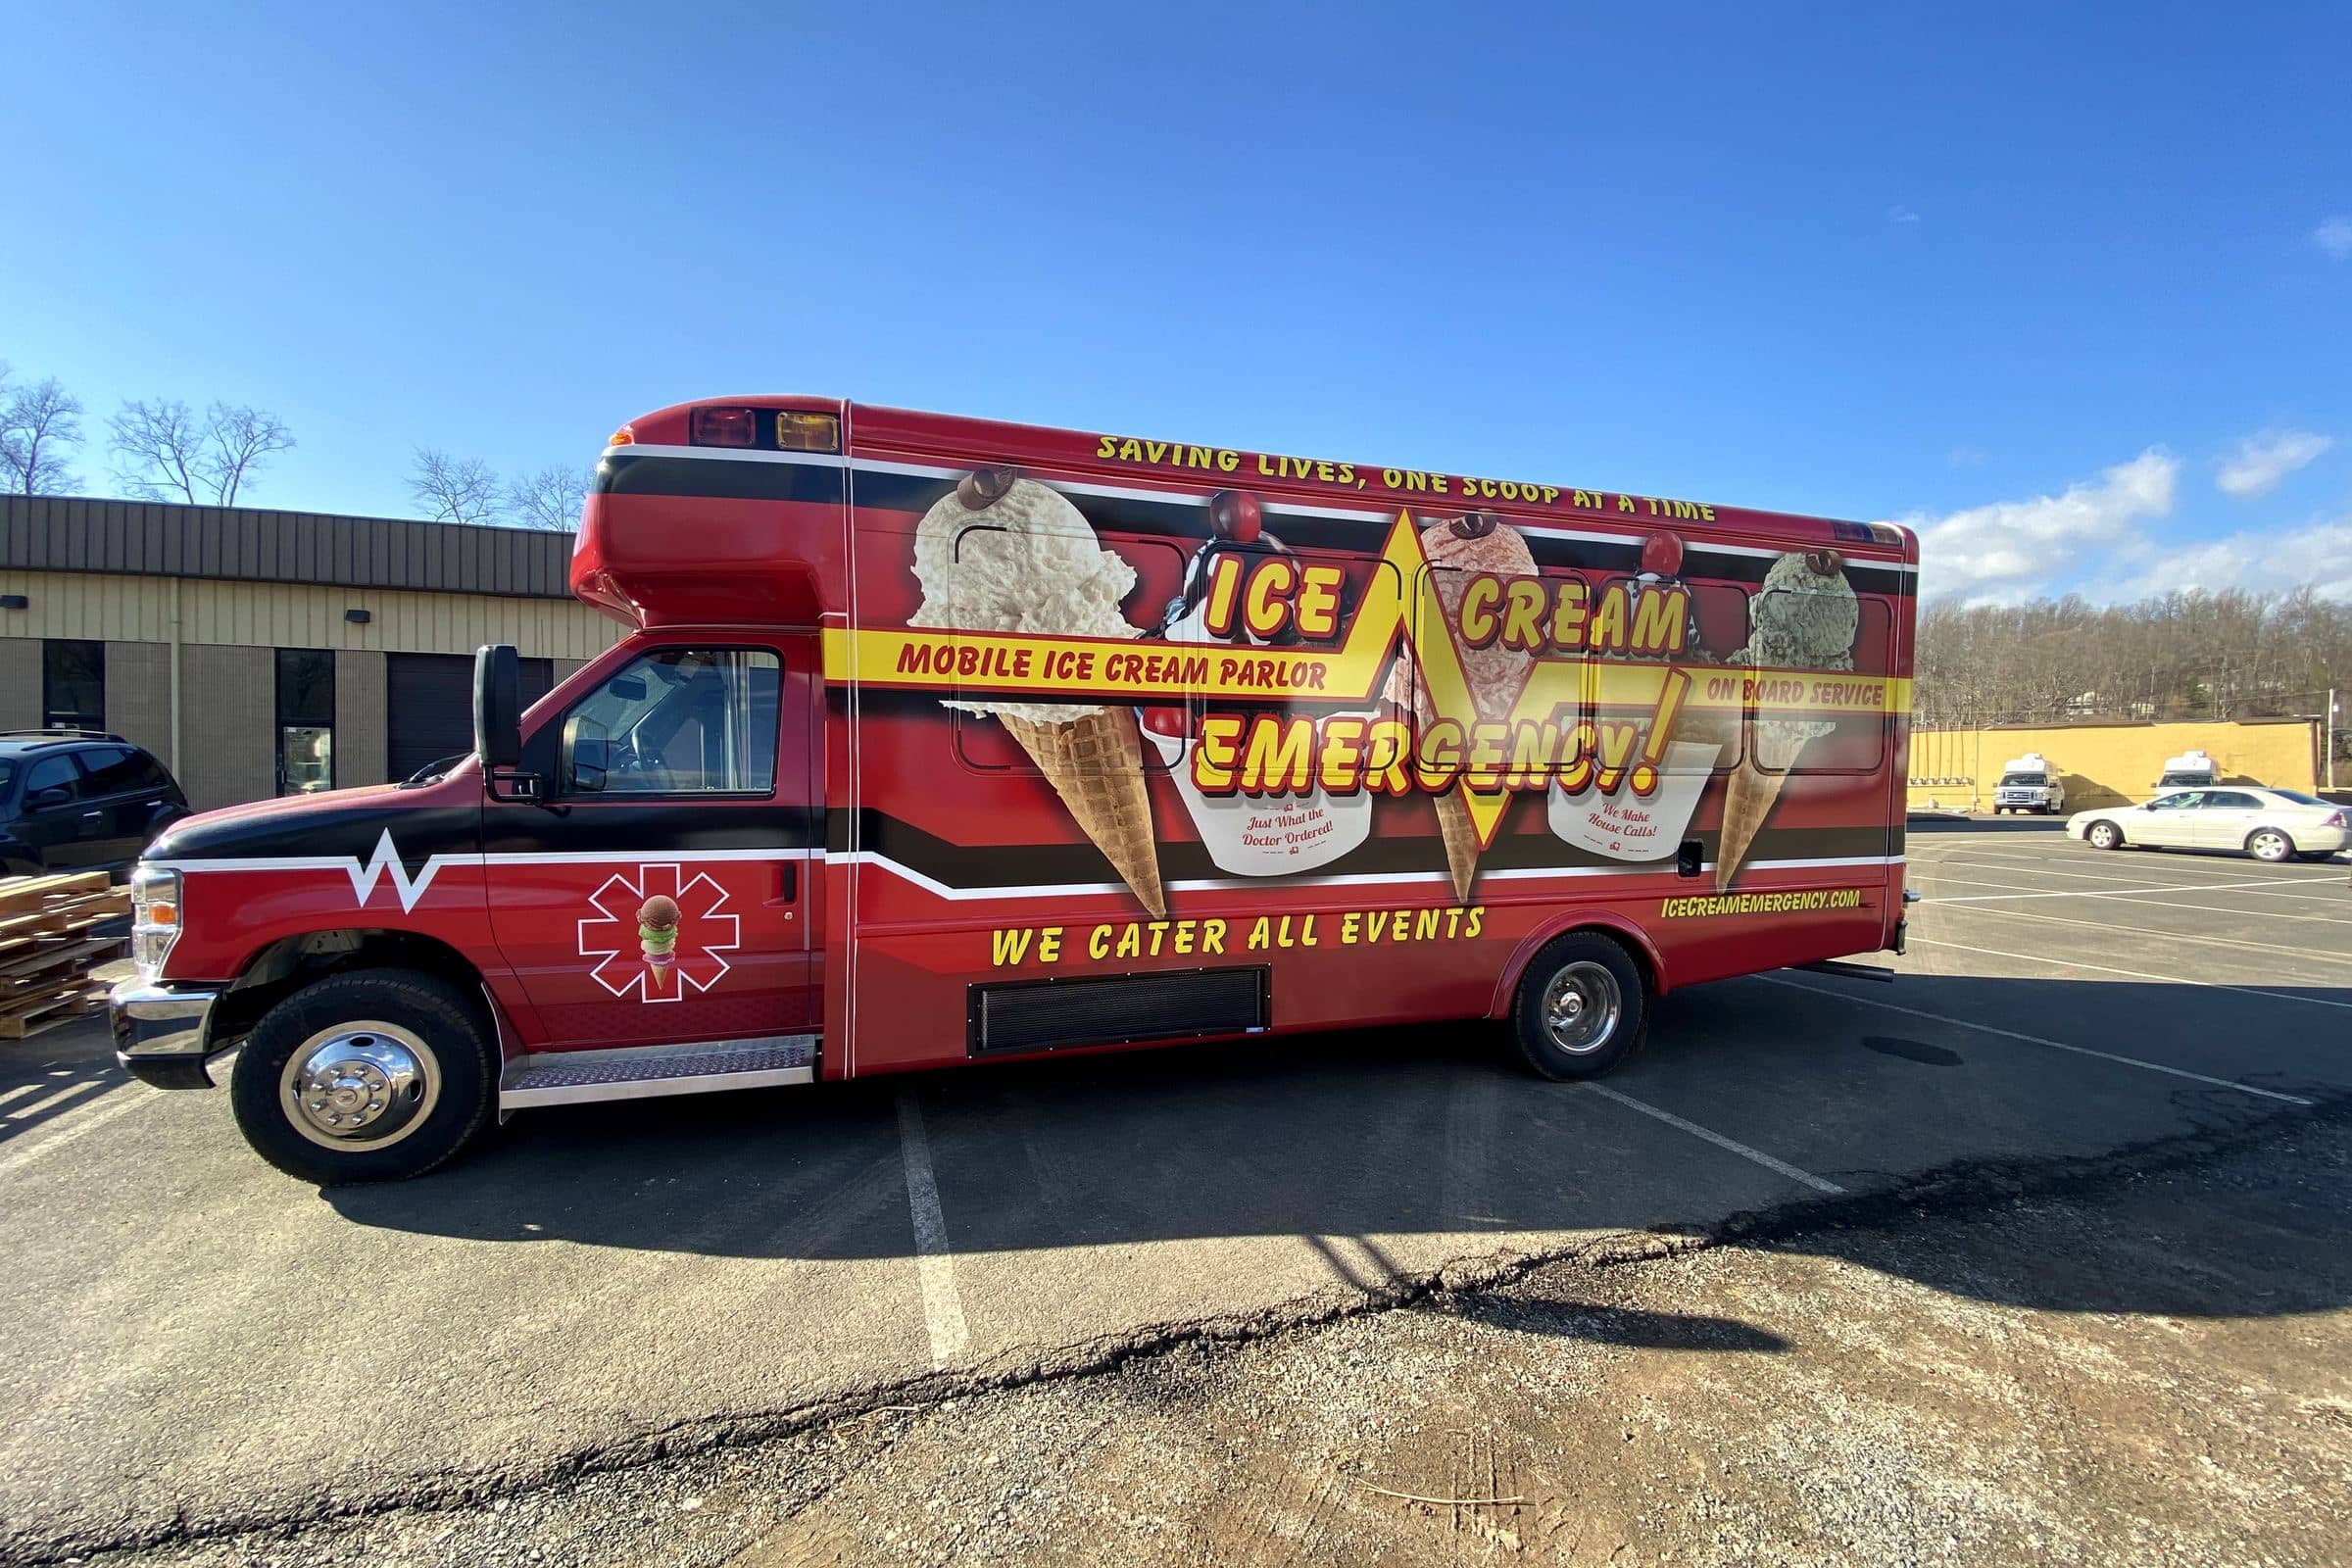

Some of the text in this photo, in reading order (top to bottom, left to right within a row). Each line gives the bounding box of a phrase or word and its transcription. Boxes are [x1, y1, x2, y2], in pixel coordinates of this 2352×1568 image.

[1097, 435, 1716, 522] SAVING LIVES, ONE SCOOP AT A TIME
[1205, 552, 1690, 655] ICE CREAM
[896, 643, 1327, 691] MOBILE ICE CREAM PARLOR
[1707, 677, 1884, 707] ON BOARD SERVICE
[1191, 663, 1693, 798] EMERGENCY!
[1247, 808, 1325, 831] Just What the
[1588, 812, 1658, 837] House Calls!
[1602, 802, 1650, 822] We Make
[1242, 819, 1334, 847] Doctor Ordered!
[992, 906, 1487, 966] WE CATER ALL EVENTS
